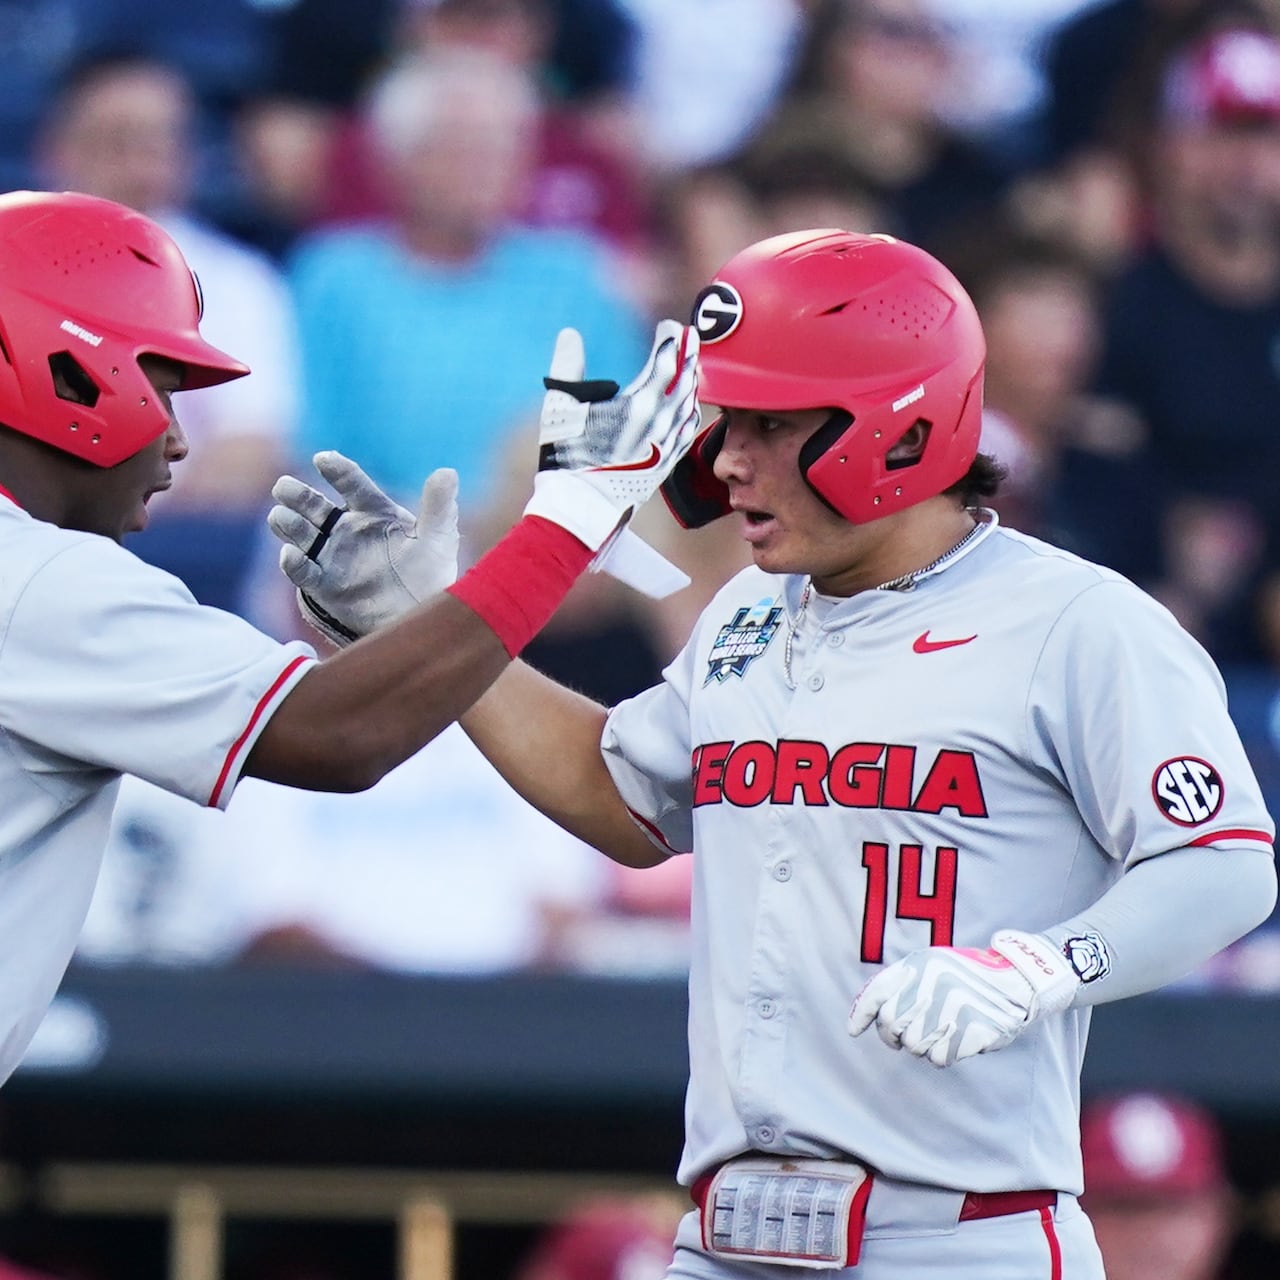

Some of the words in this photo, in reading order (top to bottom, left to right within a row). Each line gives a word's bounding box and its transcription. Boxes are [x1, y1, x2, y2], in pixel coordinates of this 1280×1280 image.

[60, 319, 104, 347] marucci
[693, 285, 742, 340] G
[1156, 758, 1221, 823] SEC
[860, 841, 959, 964] 14
